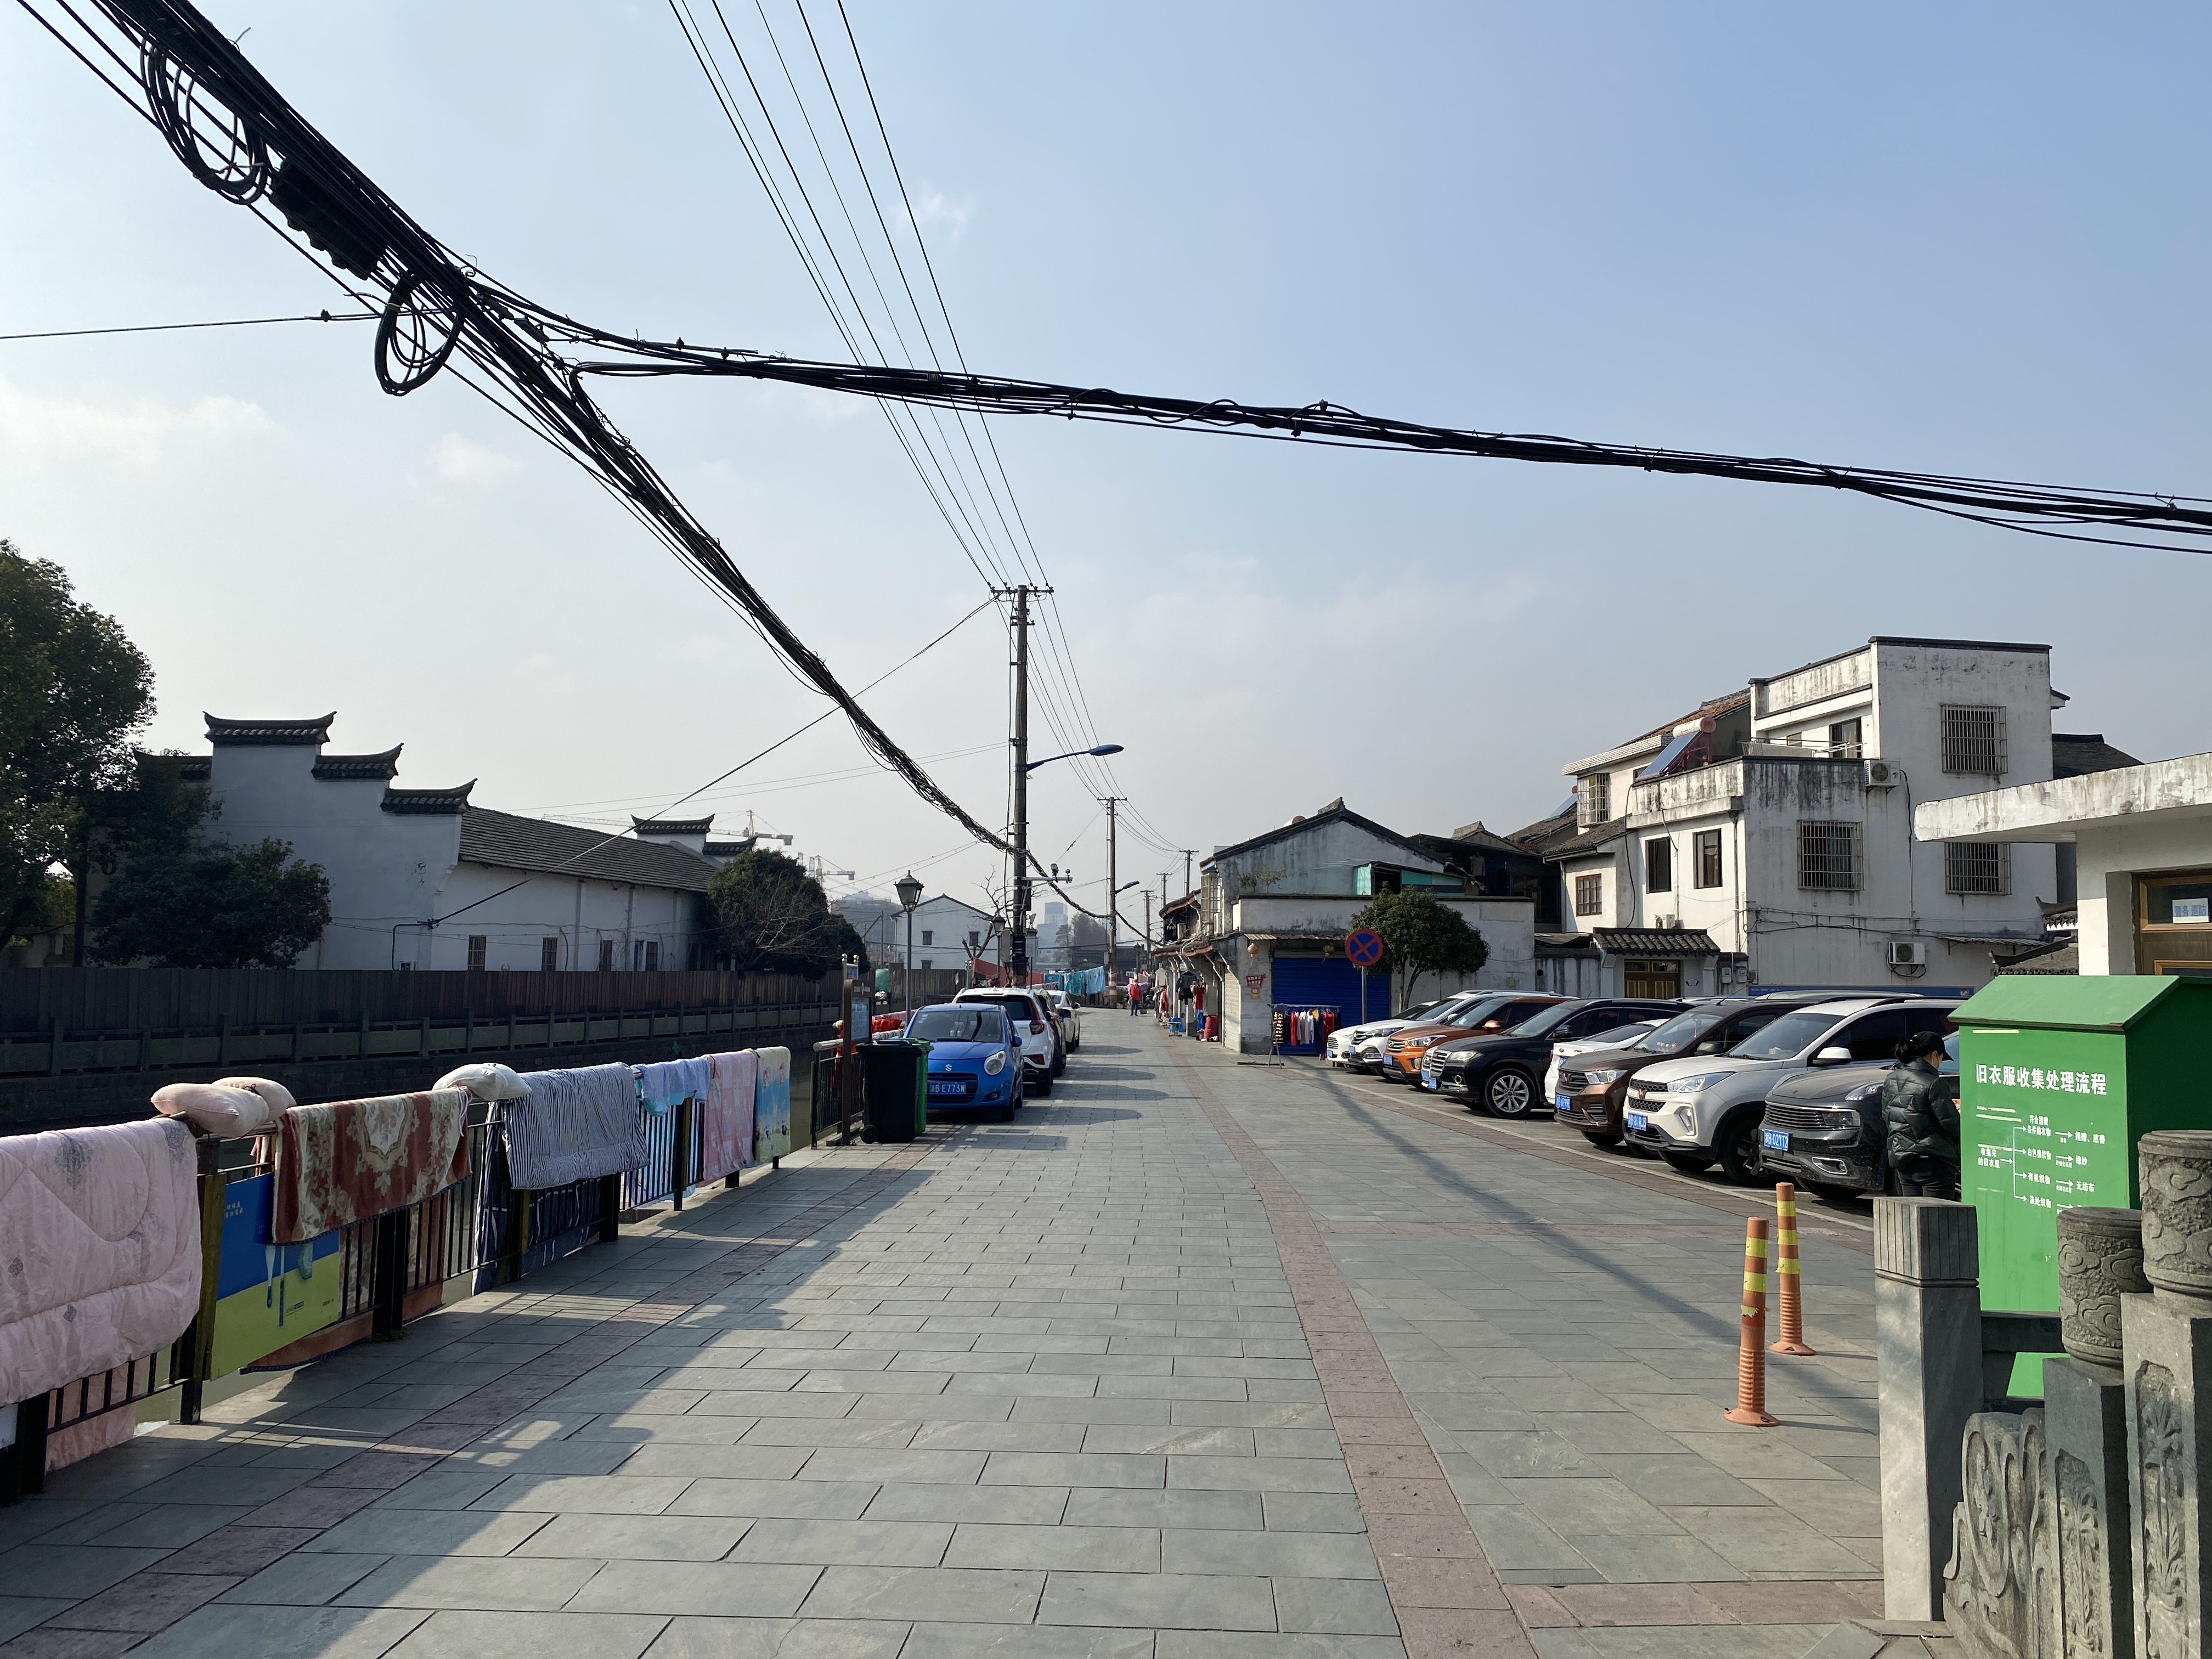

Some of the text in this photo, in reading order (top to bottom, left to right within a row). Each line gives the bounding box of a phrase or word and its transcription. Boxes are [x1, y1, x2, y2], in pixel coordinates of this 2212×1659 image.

[2174, 904, 2207, 917] 警务 巡防
[1976, 1064, 2107, 1096] 旧衣服收集处理流程
[1978, 1156, 2001, 1169] 的旧衣服
[2076, 1181, 2095, 1193] 无纺布
